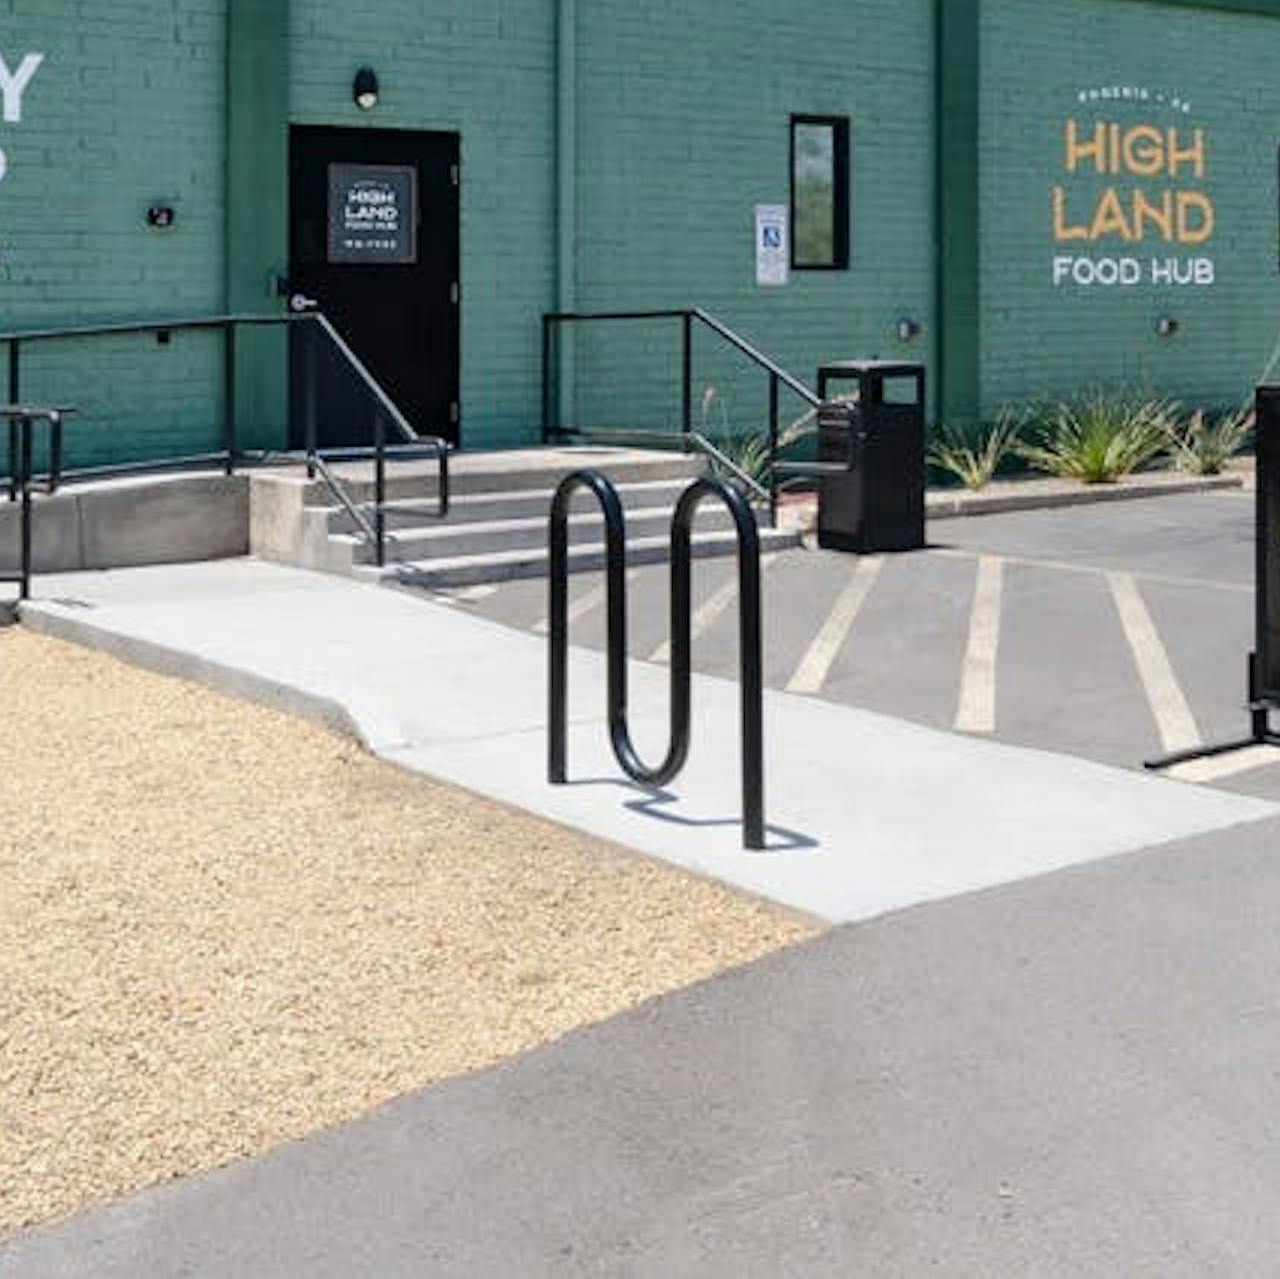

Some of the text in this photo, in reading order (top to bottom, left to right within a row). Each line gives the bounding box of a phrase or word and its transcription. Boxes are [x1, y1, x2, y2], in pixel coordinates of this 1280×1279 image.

[1065, 118, 1206, 179] HIGH
[348, 189, 396, 204] HIGH
[344, 205, 399, 221] LAND
[1052, 186, 1215, 245] LAND
[1053, 256, 1215, 286] FOOD HUB
